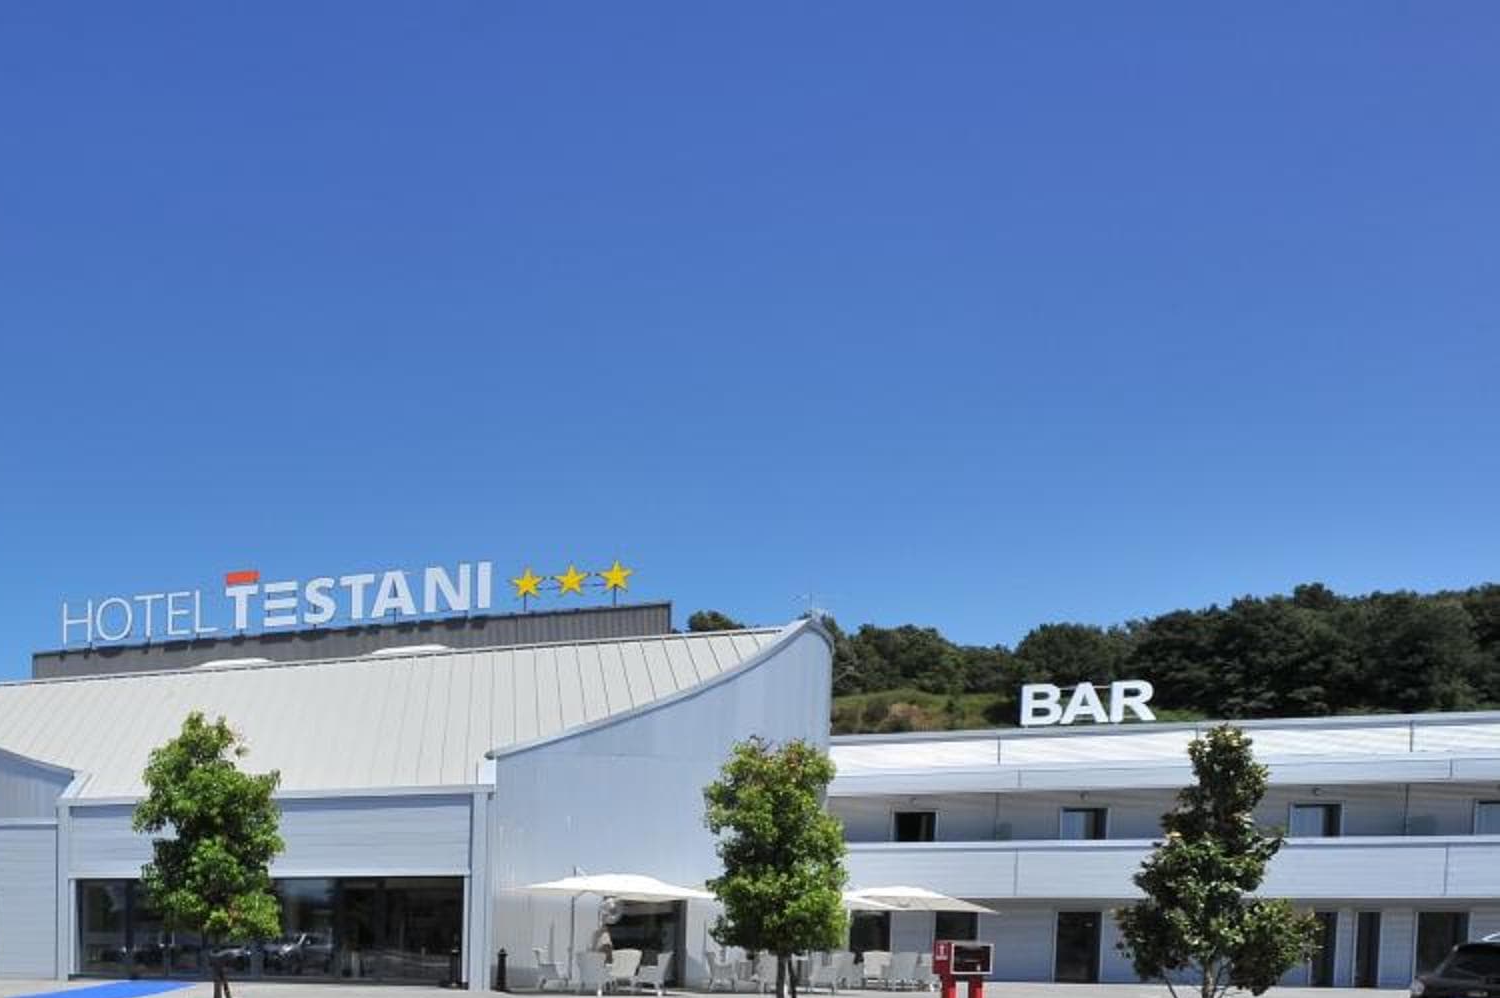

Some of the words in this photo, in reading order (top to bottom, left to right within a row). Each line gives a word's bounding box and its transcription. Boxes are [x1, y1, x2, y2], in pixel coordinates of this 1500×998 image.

[62, 590, 218, 643] HOTEL
[225, 561, 492, 629] TESTANI
[1020, 679, 1156, 726] BAR
